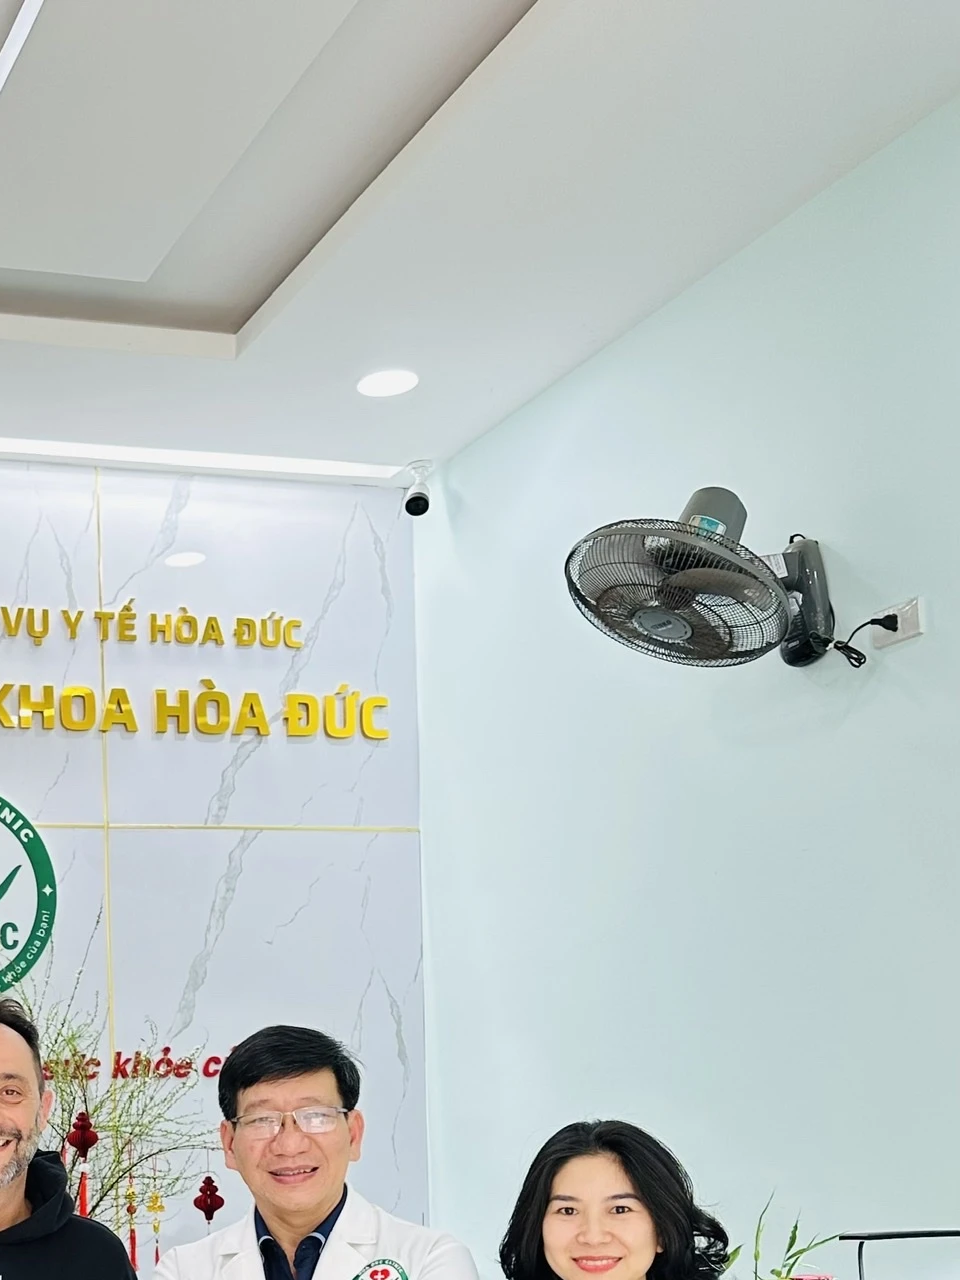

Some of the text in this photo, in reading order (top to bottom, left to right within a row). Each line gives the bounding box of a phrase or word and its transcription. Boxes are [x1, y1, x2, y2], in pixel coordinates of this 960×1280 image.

[0, 606, 50, 646] VỤ
[61, 610, 84, 640] Y
[94, 598, 138, 642] TẾ
[150, 607, 225, 646] HÒA
[233, 611, 306, 650] ĐỨC
[154, 678, 271, 736] HÒA
[282, 683, 390, 740] ĐỨC
[27, 940, 41, 960] của
